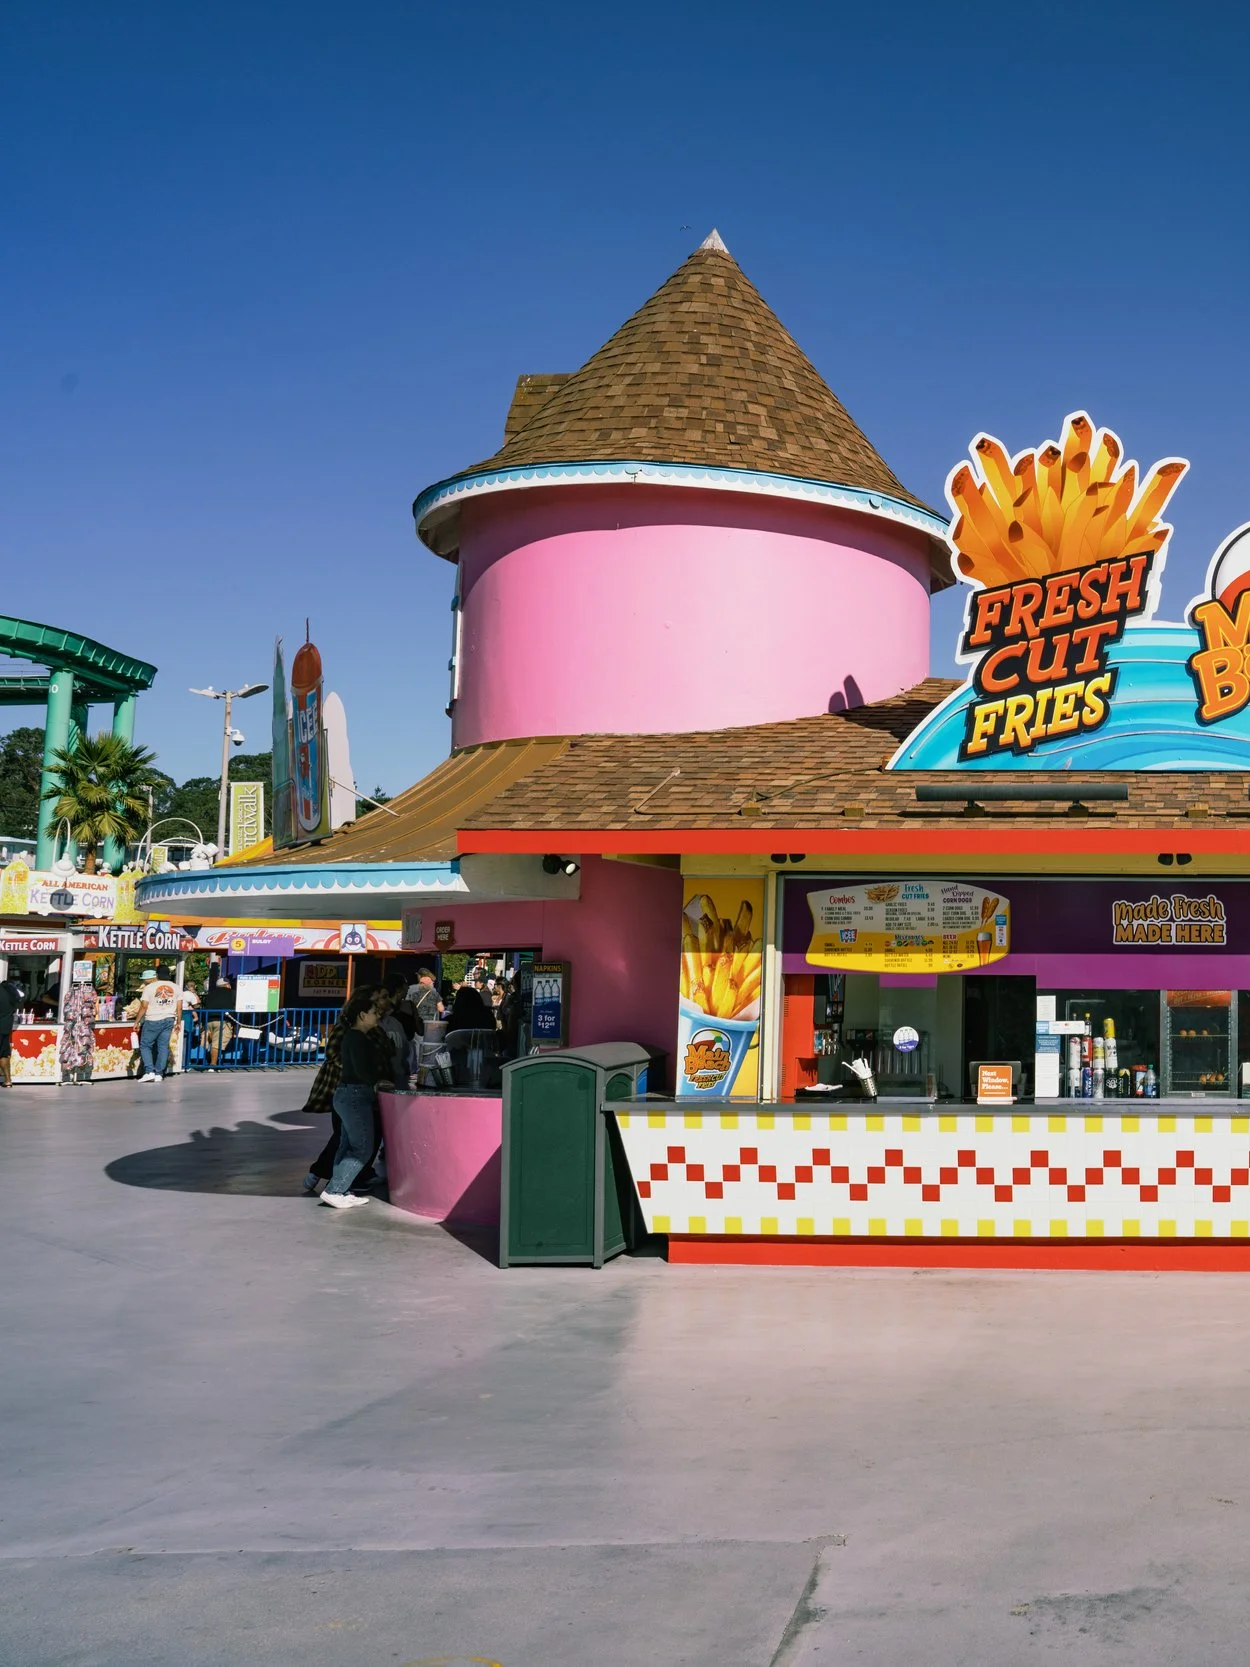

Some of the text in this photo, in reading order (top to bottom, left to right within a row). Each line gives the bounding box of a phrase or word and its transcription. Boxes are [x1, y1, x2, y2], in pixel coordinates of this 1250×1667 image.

[970, 555, 1147, 646] FRESH
[981, 620, 1118, 693] CUT
[297, 701, 319, 744] ICEE
[967, 673, 1111, 755] FRIES
[42, 880, 109, 891] ALL AMERICAN
[30, 890, 115, 910] KETTLE CORN
[1172, 895, 1225, 921] Fresh
[98, 925, 144, 950] KETTLE
[145, 927, 181, 951] CORN
[437, 933, 450, 941] HERE
[1114, 924, 1225, 943] MADE HERE
[0, 940, 56, 951] KETTLE CORN
[235, 940, 242, 948] 5
[534, 964, 562, 972] NAPKINS
[687, 1044, 730, 1062] Main
[684, 1056, 731, 1075] Beach
[689, 1072, 727, 1082] FRESH CUT
